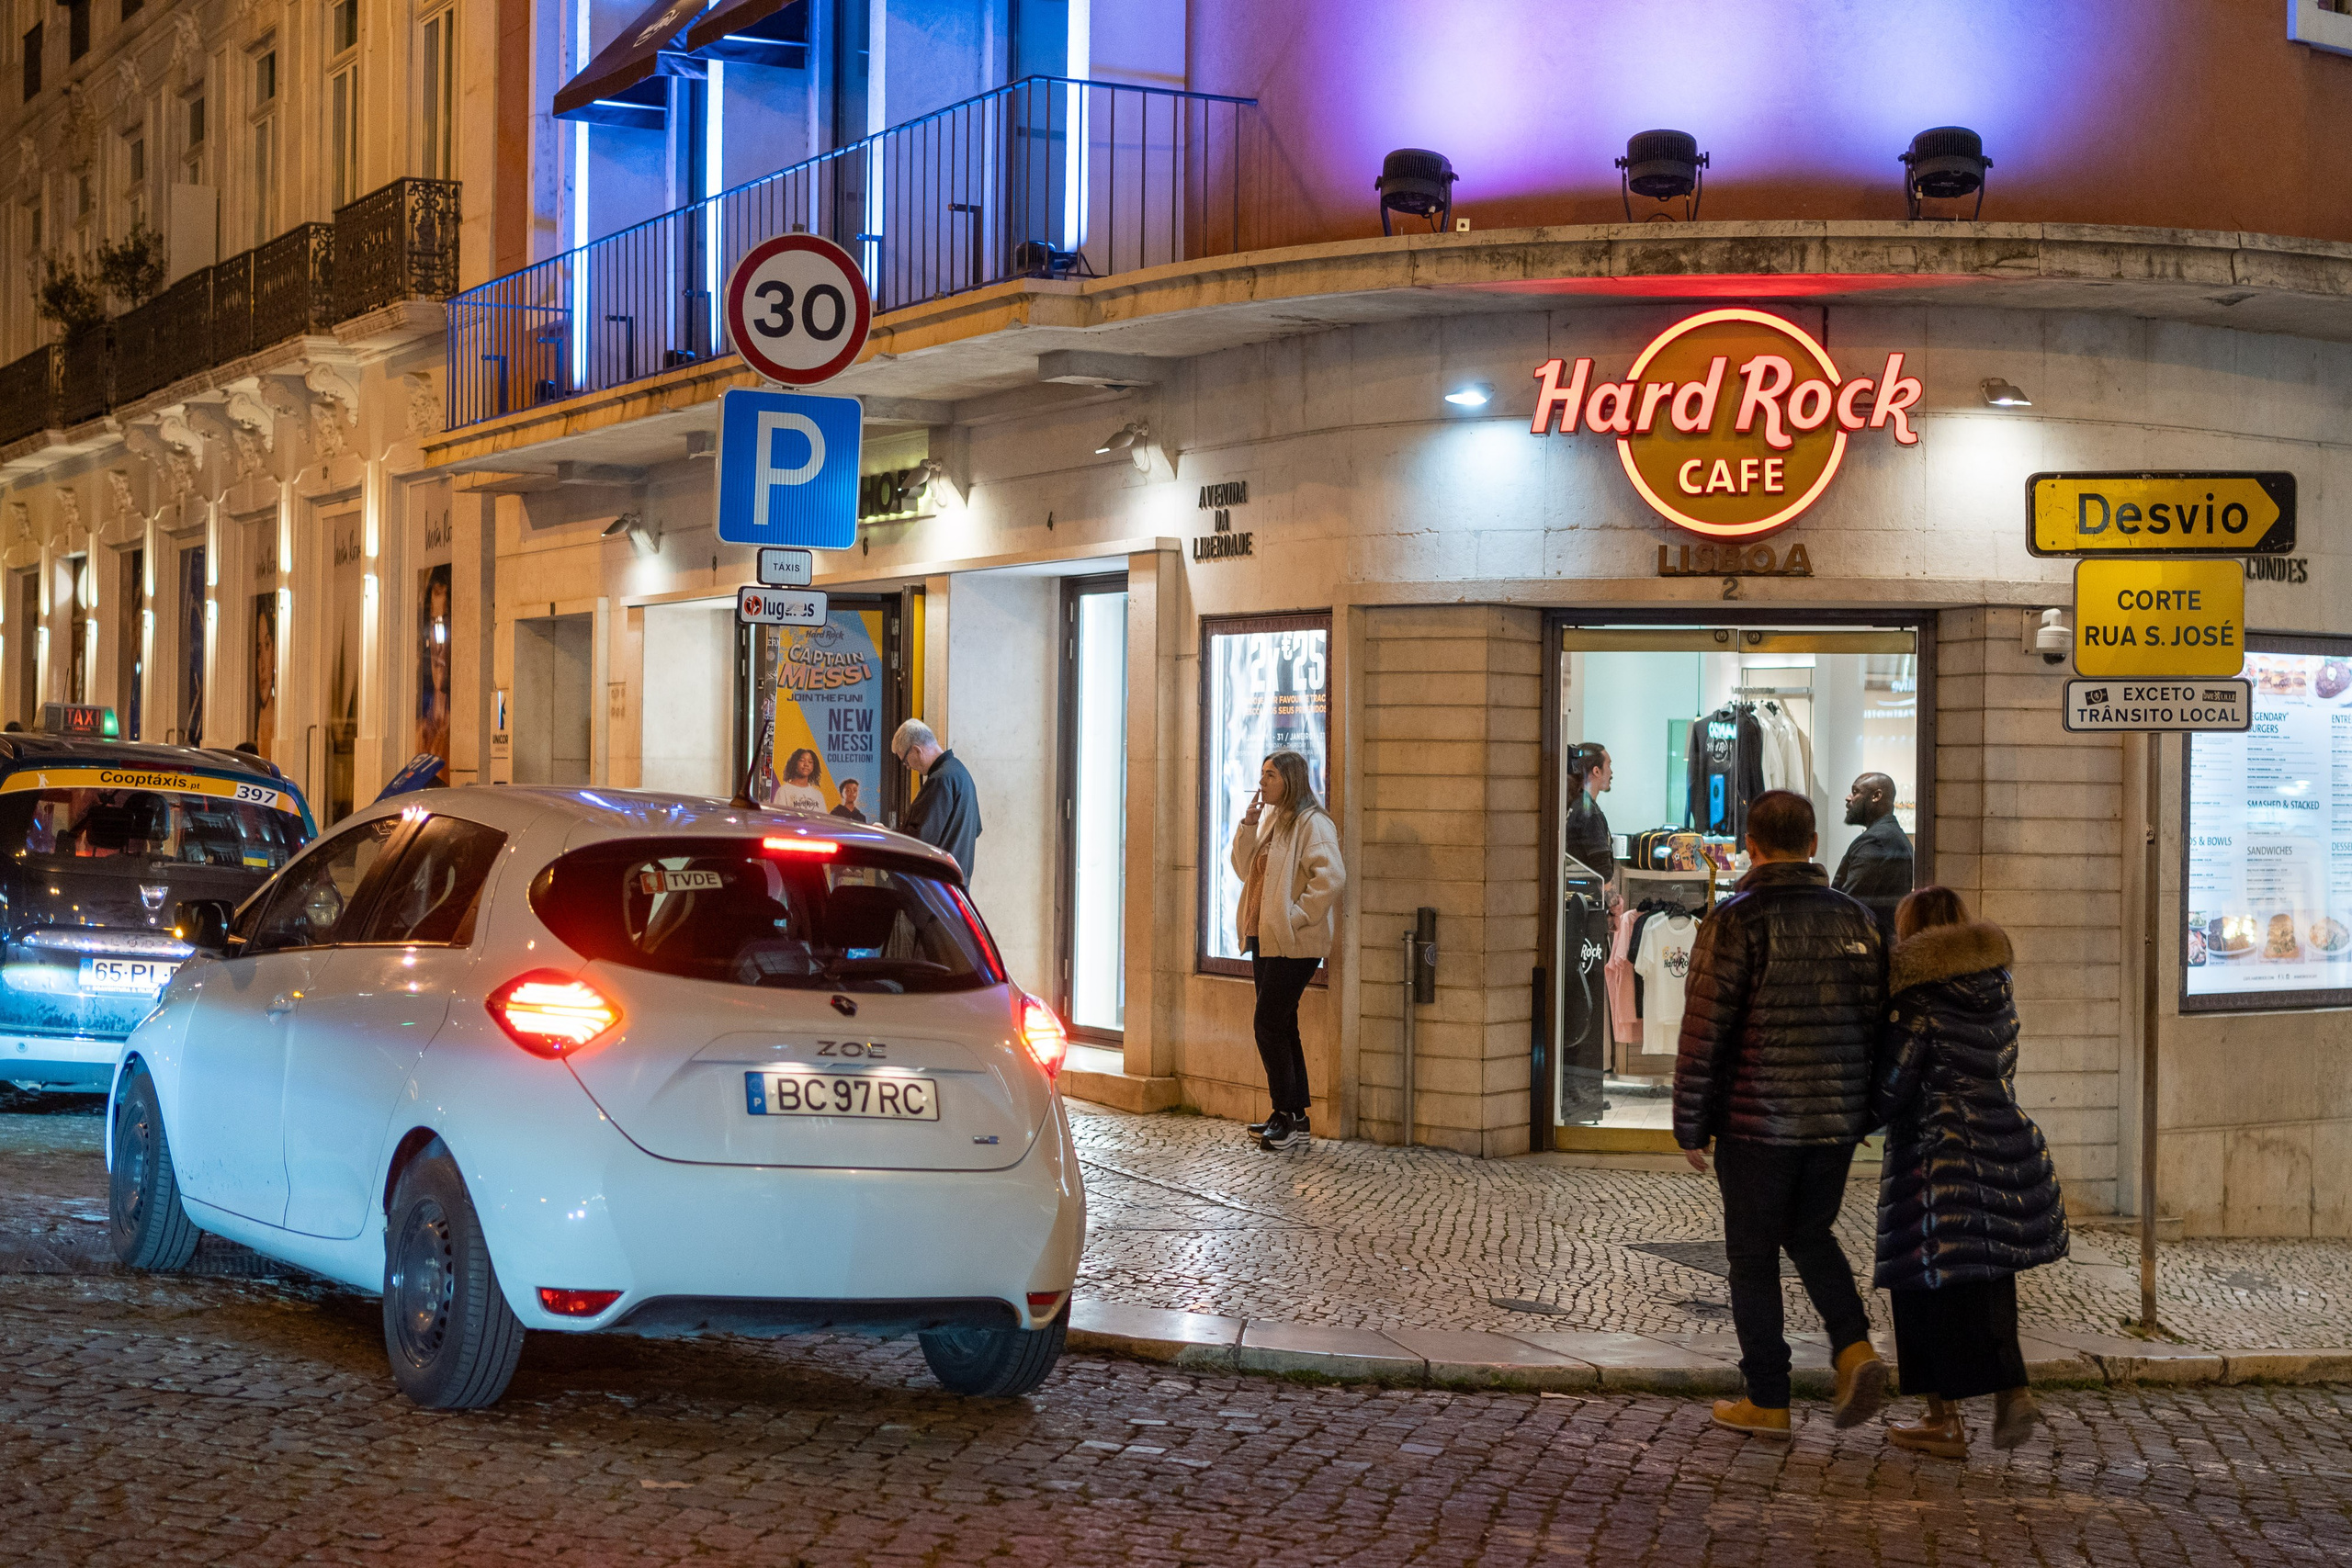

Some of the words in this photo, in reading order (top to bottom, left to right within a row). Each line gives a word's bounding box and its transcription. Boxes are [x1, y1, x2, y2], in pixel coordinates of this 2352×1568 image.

[753, 279, 846, 341] 30
[1531, 355, 1730, 436] Hard
[1735, 353, 1923, 449] Rock
[753, 411, 826, 525] P
[1678, 457, 1784, 494] CAFE
[1198, 480, 1247, 510] AVENIDA
[1046, 511, 1054, 531] 4
[1215, 508, 1230, 533] DA
[2078, 492, 2249, 536] Desvio
[863, 536, 869, 556] 6
[1193, 532, 1253, 559] LIBERDADE
[712, 555, 717, 571] 8
[773, 562, 800, 572] TÁXIS
[1658, 544, 1814, 573] LISBOA
[2246, 556, 2309, 583] CONDES
[1723, 577, 1739, 601] 2
[2117, 589, 2202, 611] CORTE
[806, 630, 825, 639] Hard
[826, 630, 844, 640] Rock
[2085, 626, 2137, 646] RUA
[2144, 625, 2165, 647] S.
[2171, 620, 2234, 647] JOSÉ
[788, 644, 865, 667] CAPTAIN
[777, 662, 873, 691] MESSI
[786, 693, 816, 702] JOIN
[816, 694, 837, 702] THE
[837, 694, 864, 703] FUN!
[2123, 687, 2195, 701] EXCETO
[66, 707, 100, 726] TAXI
[829, 708, 873, 732] NEW
[2077, 705, 2173, 723] TRÂNSITO
[2180, 708, 2241, 722] LOCAL
[2251, 712, 2287, 722] EGENDARY
[828, 734, 873, 752] MESSI
[827, 753, 874, 763] COLLECTION!
[237, 785, 277, 804] 397
[2290, 800, 2320, 810] STACKED
[2199, 837, 2205, 846] &
[2207, 836, 2233, 846] BOWLS
[2247, 846, 2293, 856] SANDWICHES
[669, 873, 718, 887] TVDE
[1580, 943, 1602, 960] Rock
[817, 1040, 888, 1059] ZOE
[753, 1097, 762, 1107] P
[777, 1077, 827, 1111] BC
[833, 1079, 871, 1112] 97
[878, 1081, 924, 1115] RC
